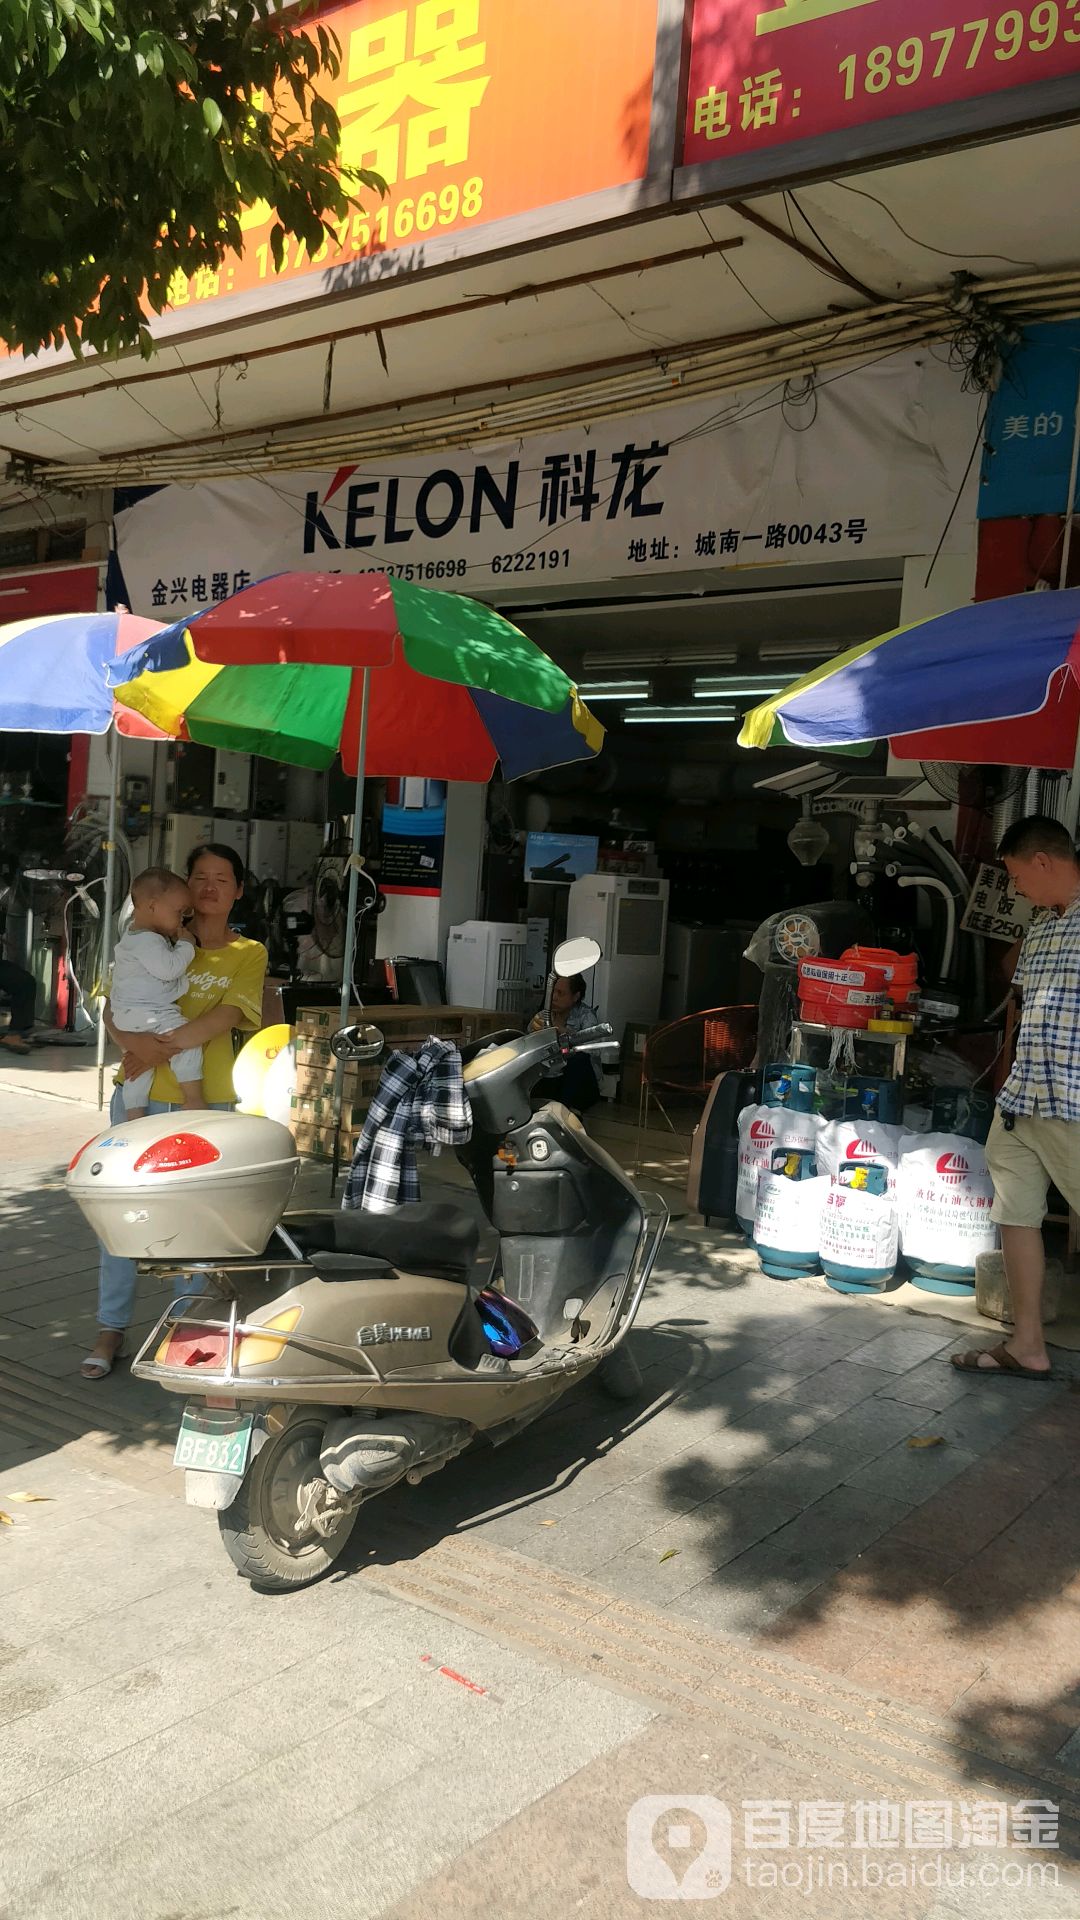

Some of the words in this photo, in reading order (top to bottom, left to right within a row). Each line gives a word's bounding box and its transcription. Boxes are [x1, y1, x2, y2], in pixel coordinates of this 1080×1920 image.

[1002, 411, 1063, 440] 美的
[303, 460, 520, 554] KELON
[539, 440, 669, 527] 科龙
[694, 518, 868, 556] 城南一路0043号
[359, 558, 467, 582] 37516698
[491, 549, 570, 573] 6222191
[151, 569, 251, 606] 金兴电器店
[179, 1436, 242, 1470] BF832
